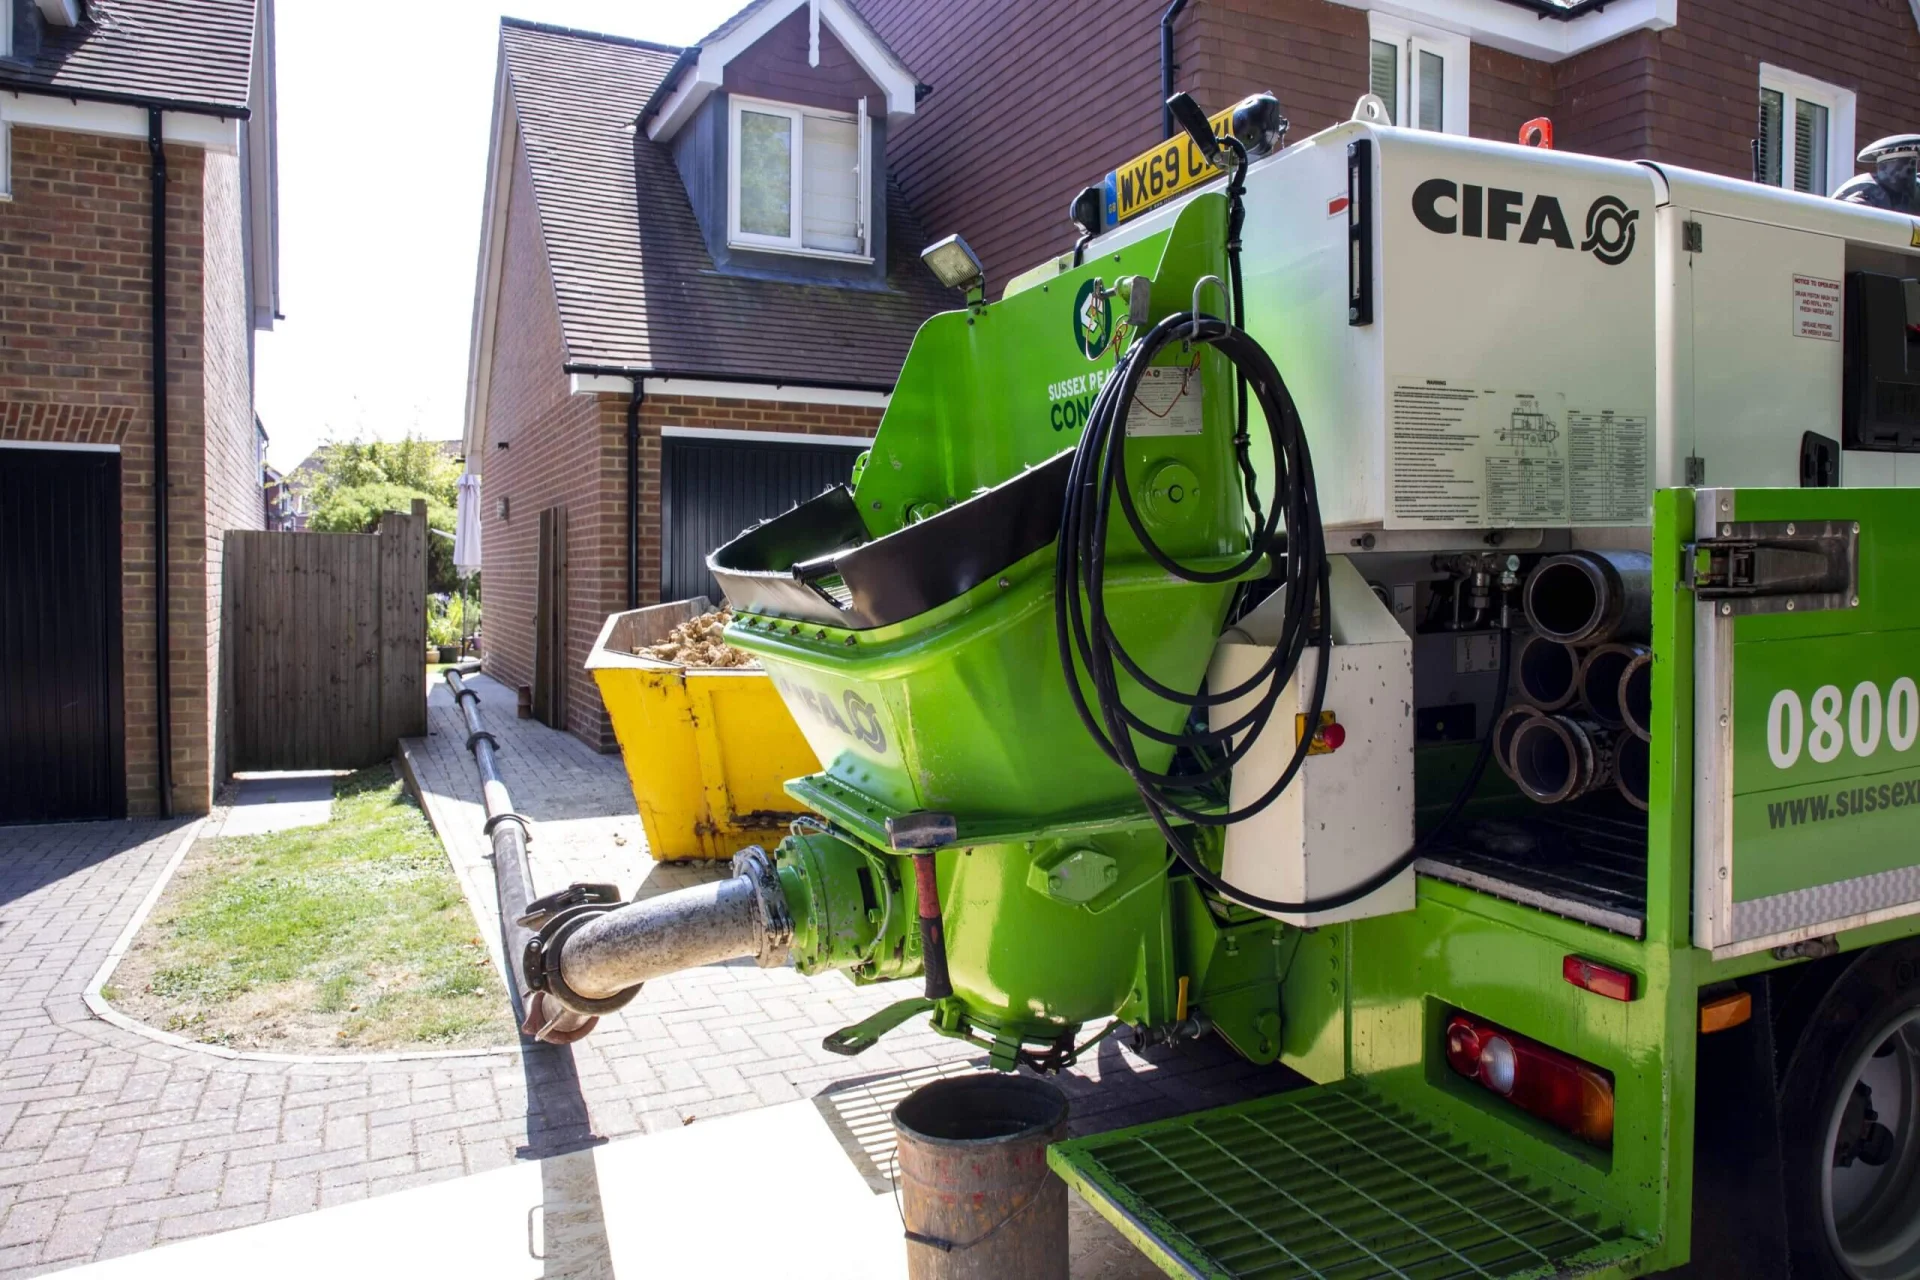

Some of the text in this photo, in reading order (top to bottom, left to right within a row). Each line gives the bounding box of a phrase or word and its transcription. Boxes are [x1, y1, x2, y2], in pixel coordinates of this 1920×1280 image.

[1120, 145, 1180, 213] WX69
[1411, 178, 1575, 250] CIFA
[1048, 375, 1087, 401] SUSSEX
[1767, 676, 1919, 769] 0800
[1767, 779, 1920, 830] www.sussex
